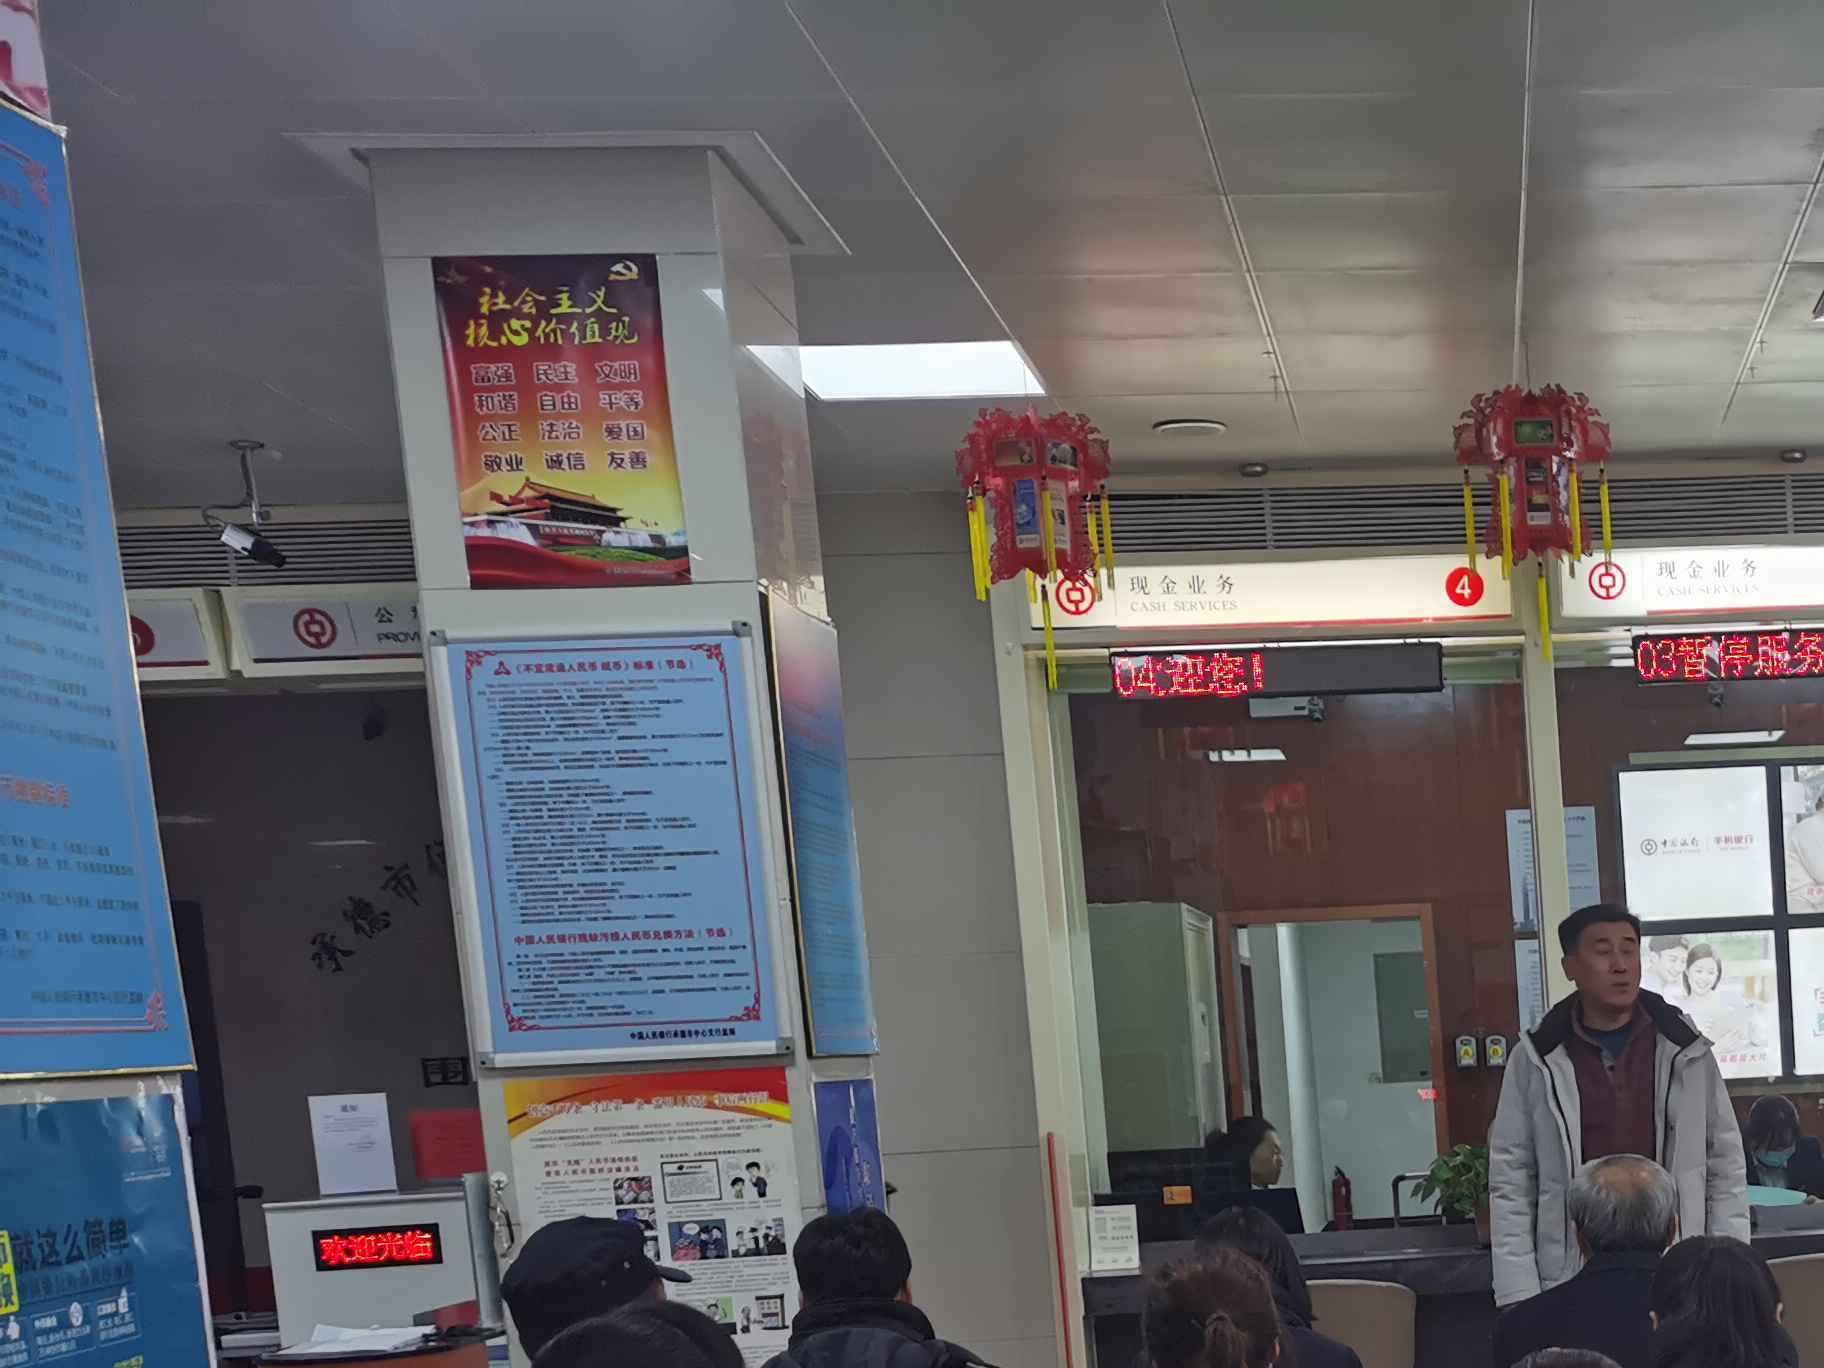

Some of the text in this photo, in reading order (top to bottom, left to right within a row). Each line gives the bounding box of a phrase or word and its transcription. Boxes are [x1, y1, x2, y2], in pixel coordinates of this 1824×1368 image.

[479, 286, 618, 315] 社会主义
[465, 316, 639, 347] 核心价值观
[472, 361, 639, 384] 富强 民主 文明
[474, 390, 643, 413] 和谐 自由 平等
[479, 421, 645, 442] 公正 法治 爱国
[483, 450, 648, 473] 敬业 诚信 友善
[1657, 558, 1759, 579] 现金业务
[1129, 574, 1236, 596] 现金业务
[1455, 577, 1471, 599] 4
[1657, 583, 1759, 597] CASH SERVICES
[1130, 599, 1238, 613] CASH SERVICES
[319, 1231, 434, 1265] 欢迎光临
